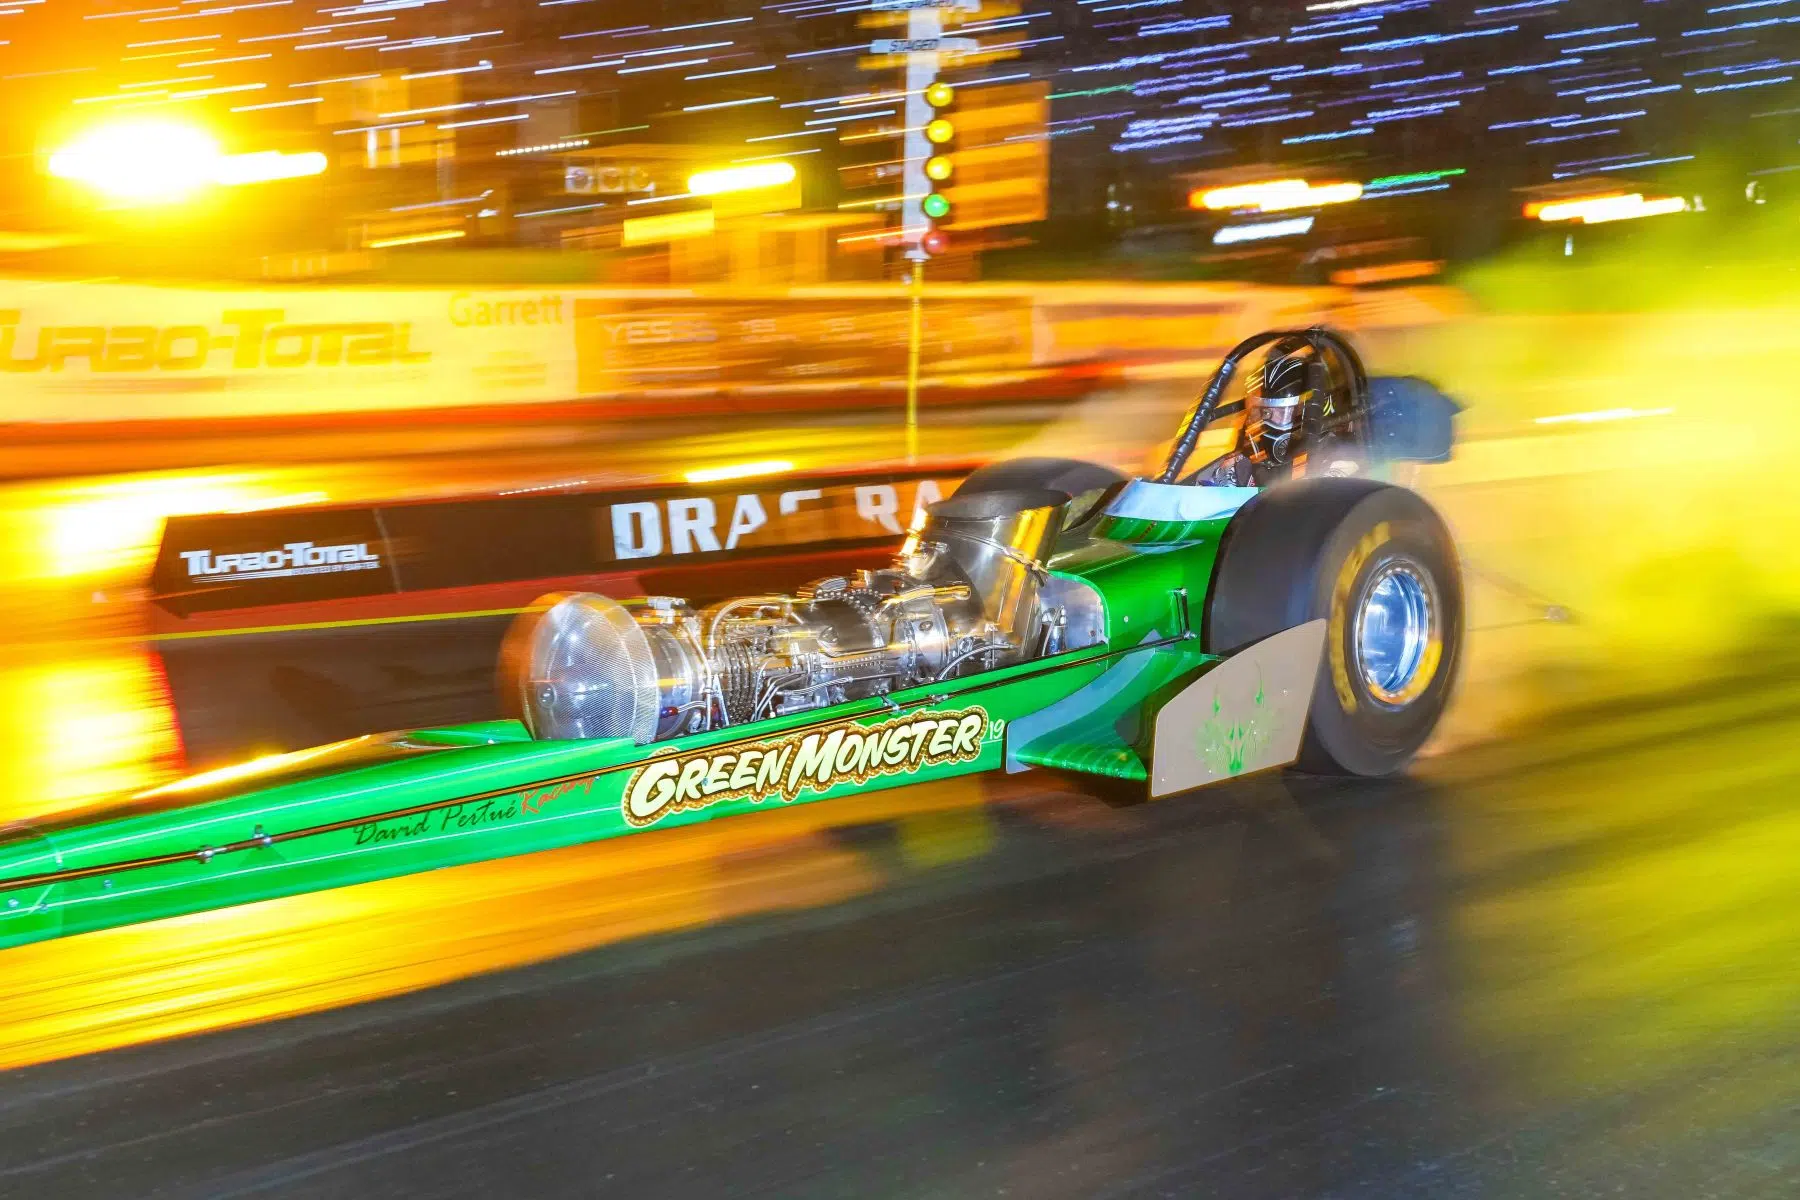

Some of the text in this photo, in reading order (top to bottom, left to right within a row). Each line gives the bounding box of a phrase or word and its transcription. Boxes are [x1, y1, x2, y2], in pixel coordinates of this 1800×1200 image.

[448, 291, 563, 327] Garrett
[627, 712, 1006, 820] GREEN MONSTER 19
[353, 811, 431, 846] David
